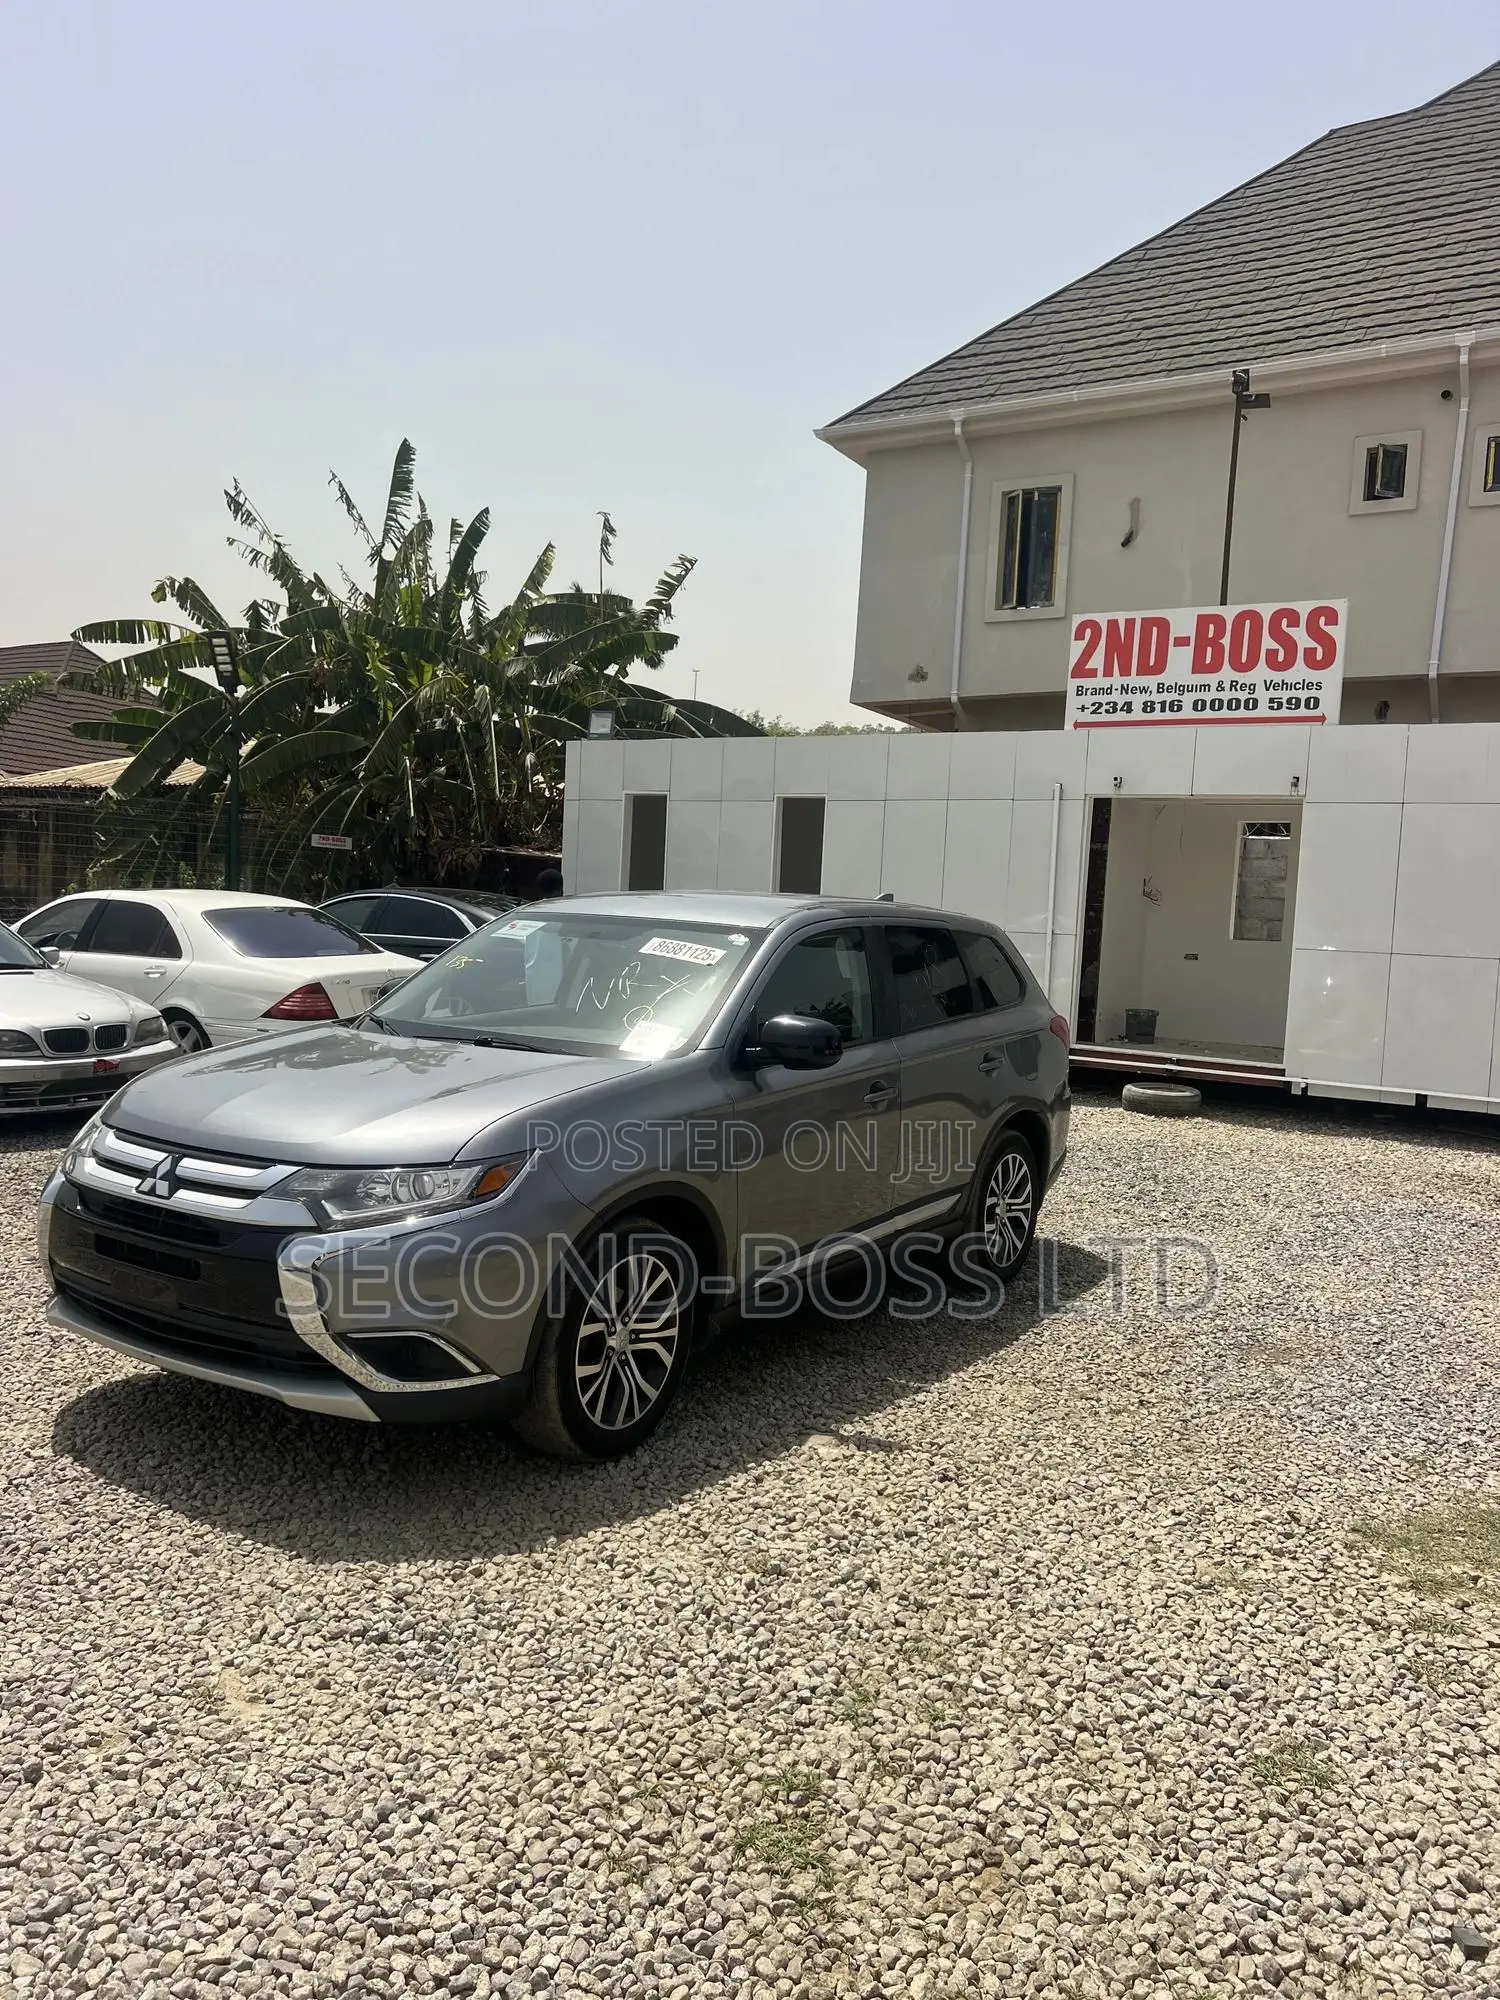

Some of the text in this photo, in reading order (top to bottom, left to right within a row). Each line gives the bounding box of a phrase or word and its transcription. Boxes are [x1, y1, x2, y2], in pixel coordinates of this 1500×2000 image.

[1071, 606, 1339, 678] 2ND-BOSS
[1076, 679, 1323, 697] Brand-New, Belguim & Reg Vehicles
[1076, 696, 1320, 715] +234 816 0000 590
